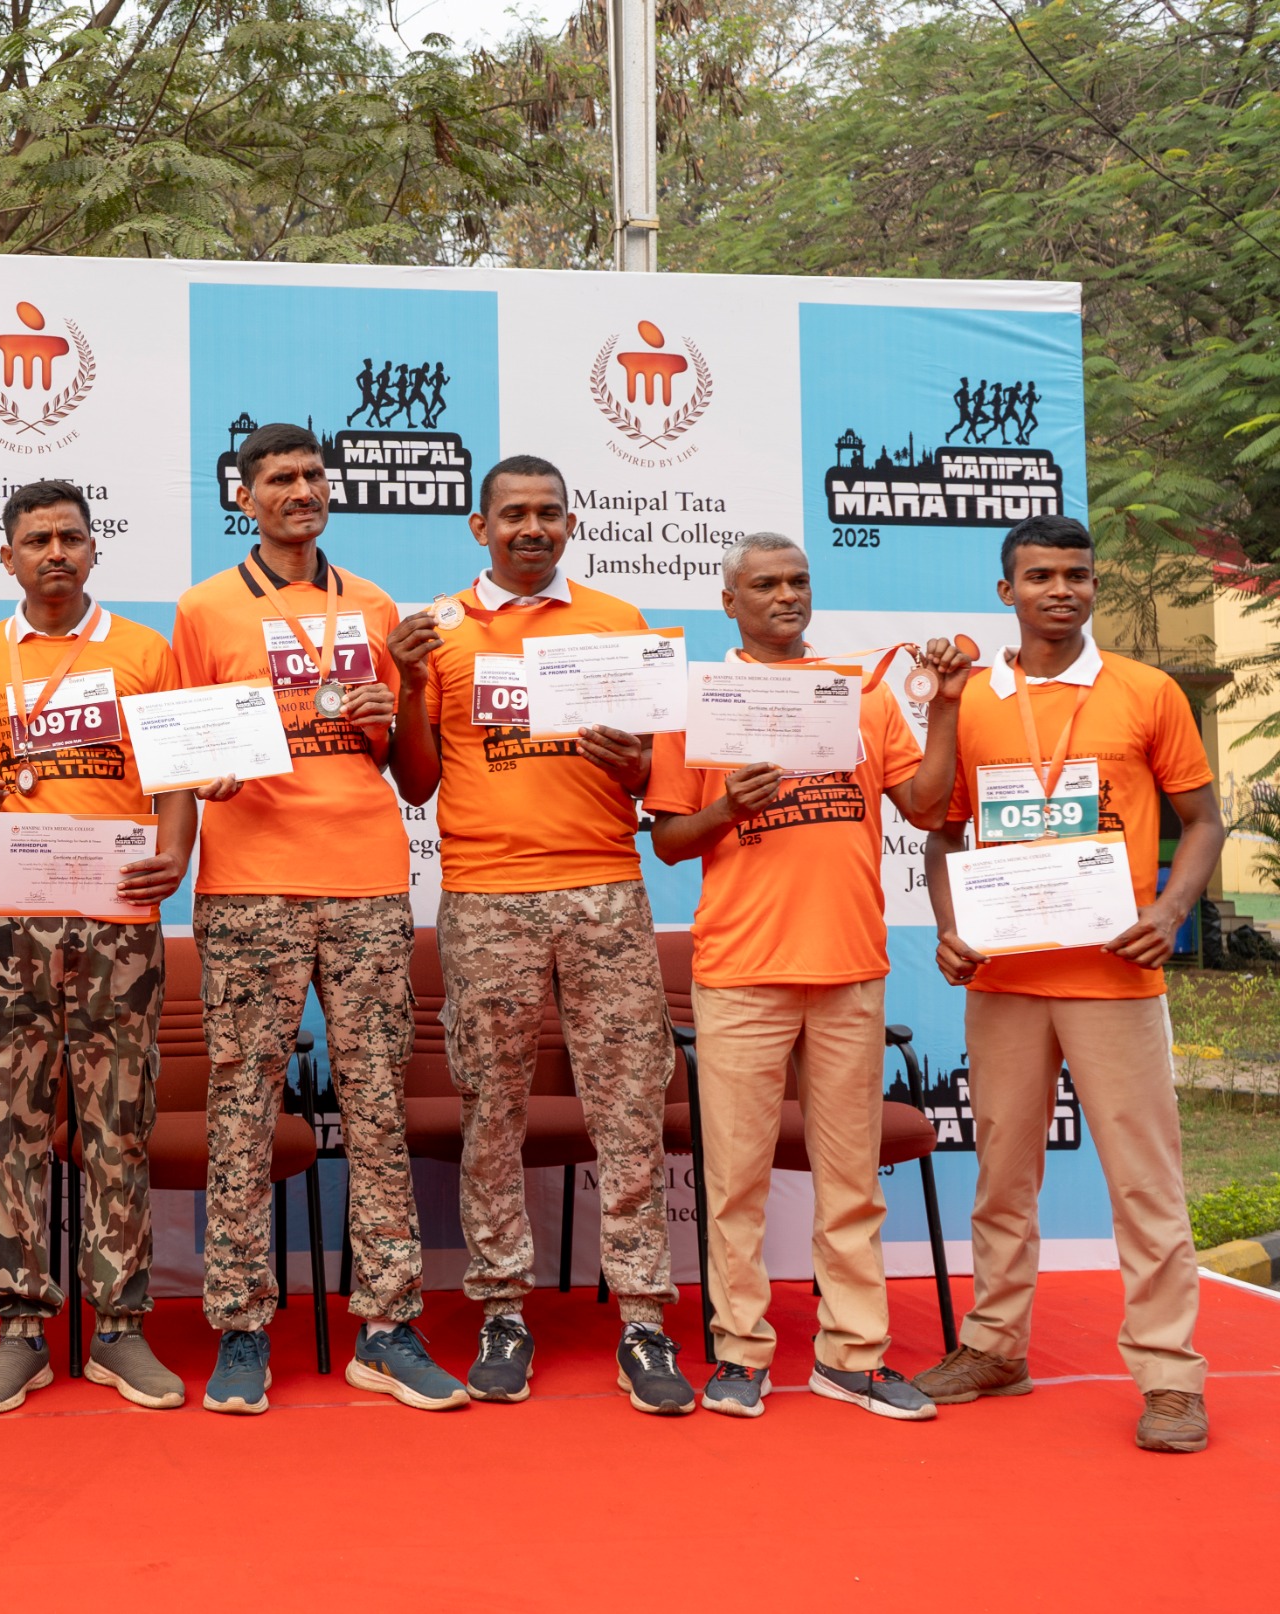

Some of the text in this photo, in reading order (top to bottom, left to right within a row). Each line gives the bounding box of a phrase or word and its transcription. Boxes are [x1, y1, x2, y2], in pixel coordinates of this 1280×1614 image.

[38, 444, 53, 454] BY
[57, 429, 80, 448] LIFE
[343, 439, 465, 465] MANIPAL
[606, 440, 699, 468] INSPIRED BY LIFE
[942, 455, 1057, 481] MANIPAL
[572, 489, 726, 516] Manipal Tata
[832, 480, 1058, 519] MARATHON
[224, 516, 259, 535] 202
[570, 521, 745, 549] Medical College
[833, 528, 880, 547] 2025
[585, 554, 722, 581] Jamshedpur
[286, 650, 354, 674] 097
[492, 688, 528, 710] 09
[30, 706, 102, 737] 0978
[2, 759, 123, 781] MRATHON
[489, 761, 516, 772] 2025
[798, 789, 863, 802] MANIPAL
[740, 835, 762, 846] 025
